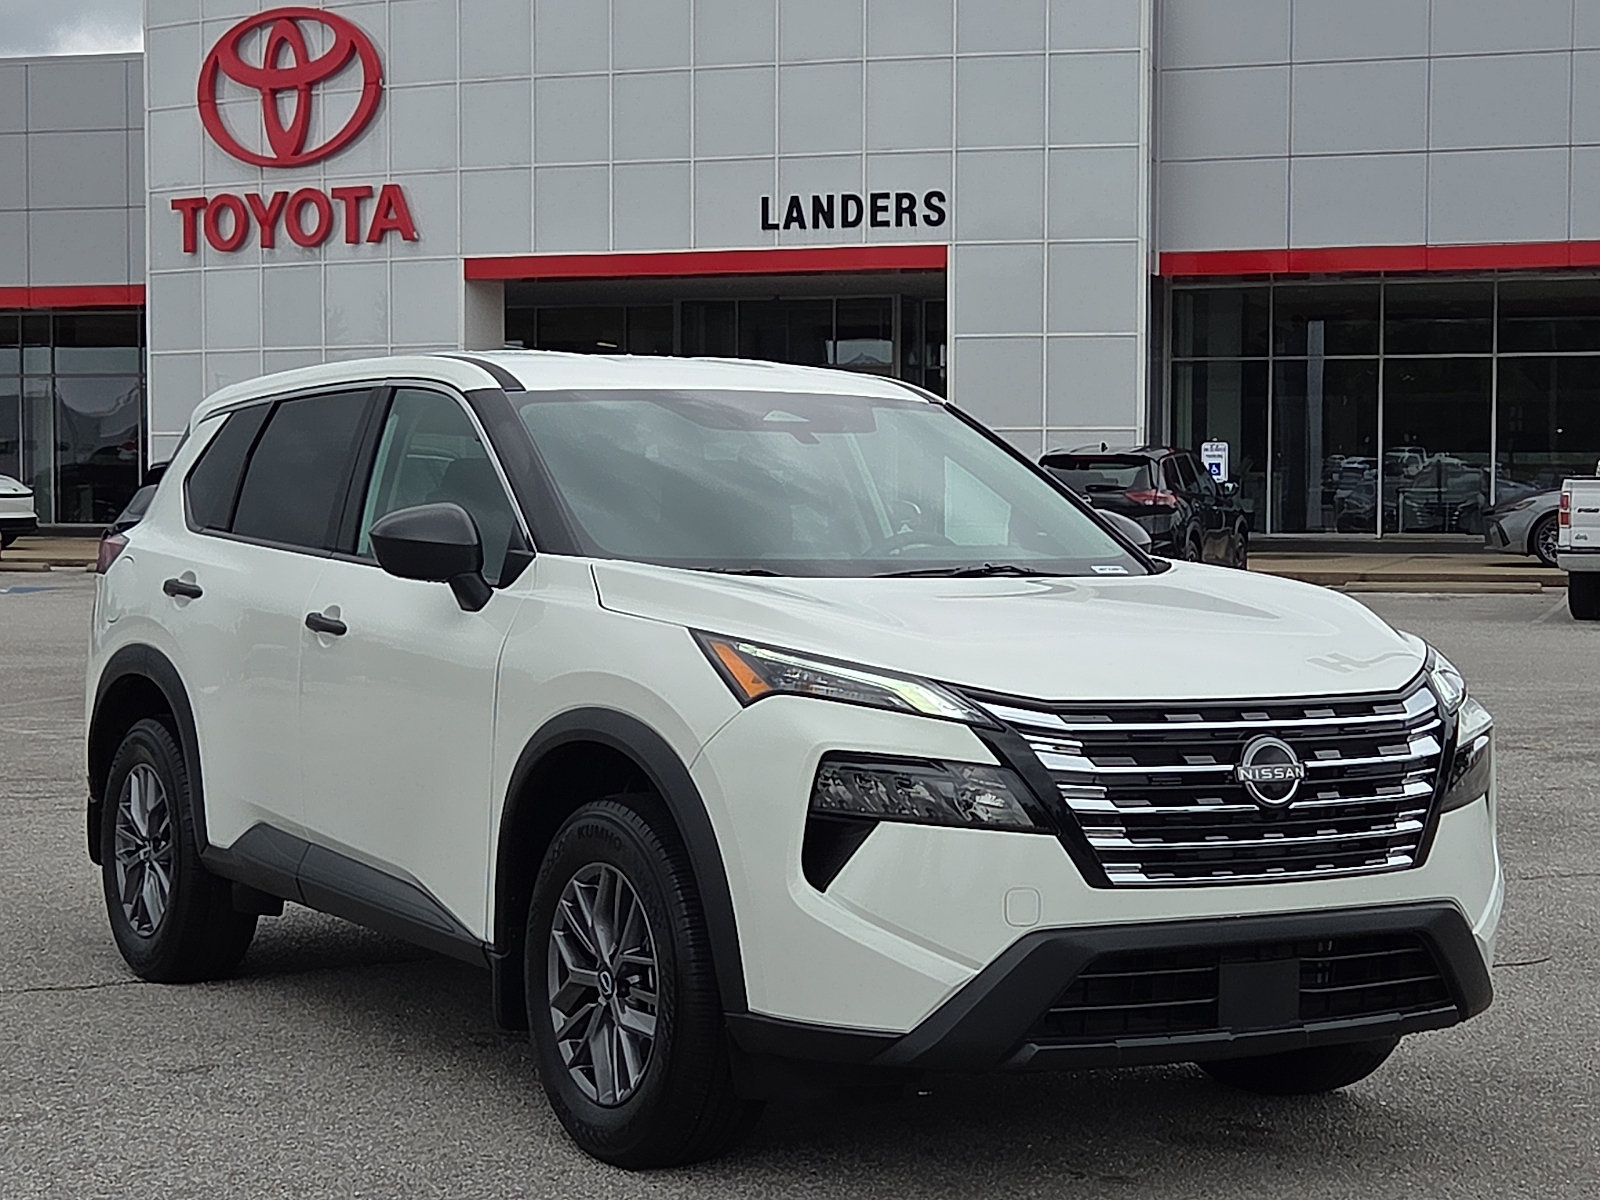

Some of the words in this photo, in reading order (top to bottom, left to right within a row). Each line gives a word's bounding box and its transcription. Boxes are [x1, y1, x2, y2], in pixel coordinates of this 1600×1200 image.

[171, 184, 418, 253] TOYOTA
[761, 191, 946, 230] LANDERS
[1239, 766, 1305, 781] NISSAN
[577, 824, 623, 852] KUMHO
